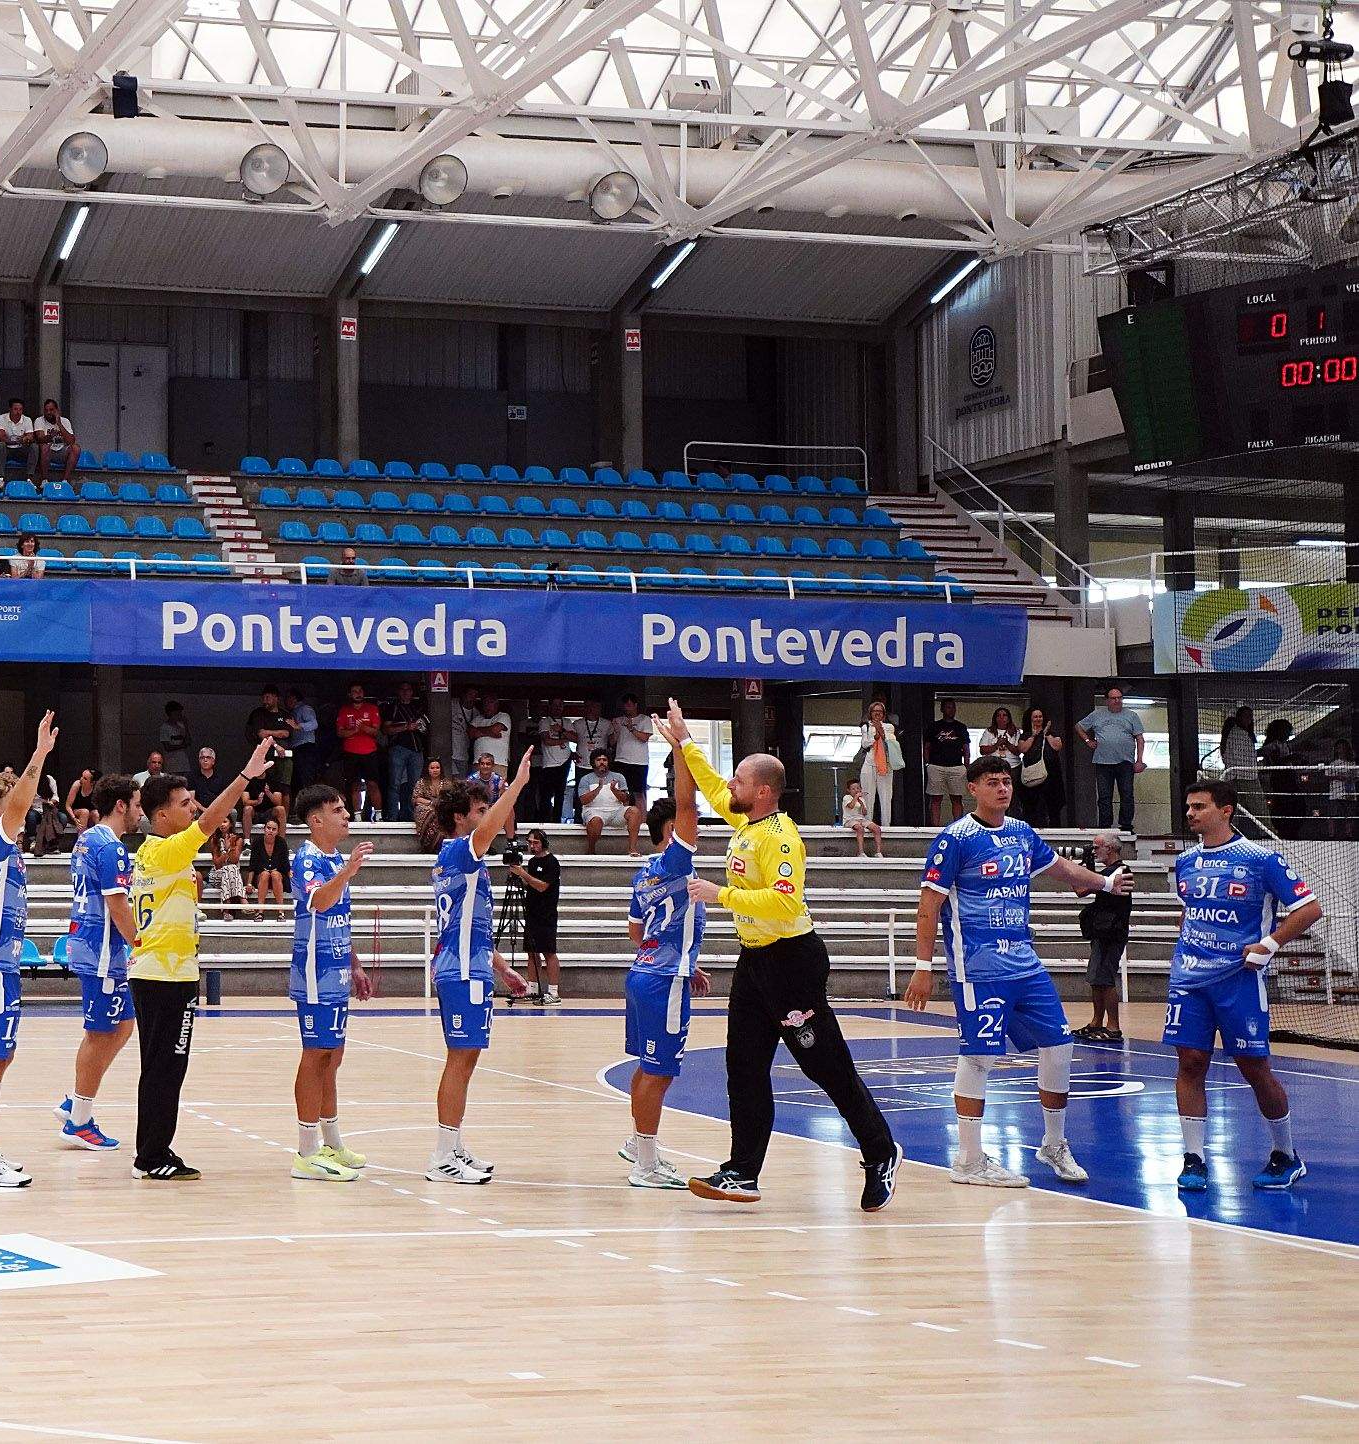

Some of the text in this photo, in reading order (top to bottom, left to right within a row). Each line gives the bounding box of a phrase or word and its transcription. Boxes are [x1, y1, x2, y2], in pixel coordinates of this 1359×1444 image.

[1246, 293, 1277, 305] LOCAL
[45, 308, 58, 316] AA
[1127, 314, 1135, 325] E
[1271, 313, 1287, 338] 0
[342, 324, 355, 332] AA
[1299, 335, 1337, 347] PERIODO
[1281, 356, 1358, 388] 00:00
[1247, 439, 1275, 449] FALTAS
[1304, 434, 1341, 445] JUGADOR
[1133, 459, 1174, 473] MONDO
[160, 600, 508, 658] Pontevedra
[641, 612, 965, 671] Pontevedra
[1002, 853, 1026, 878] 24
[1202, 859, 1228, 868] ence
[1193, 876, 1220, 899] 31
[174, 1010, 192, 1055] Kempa
[977, 1013, 1004, 1038] 24
